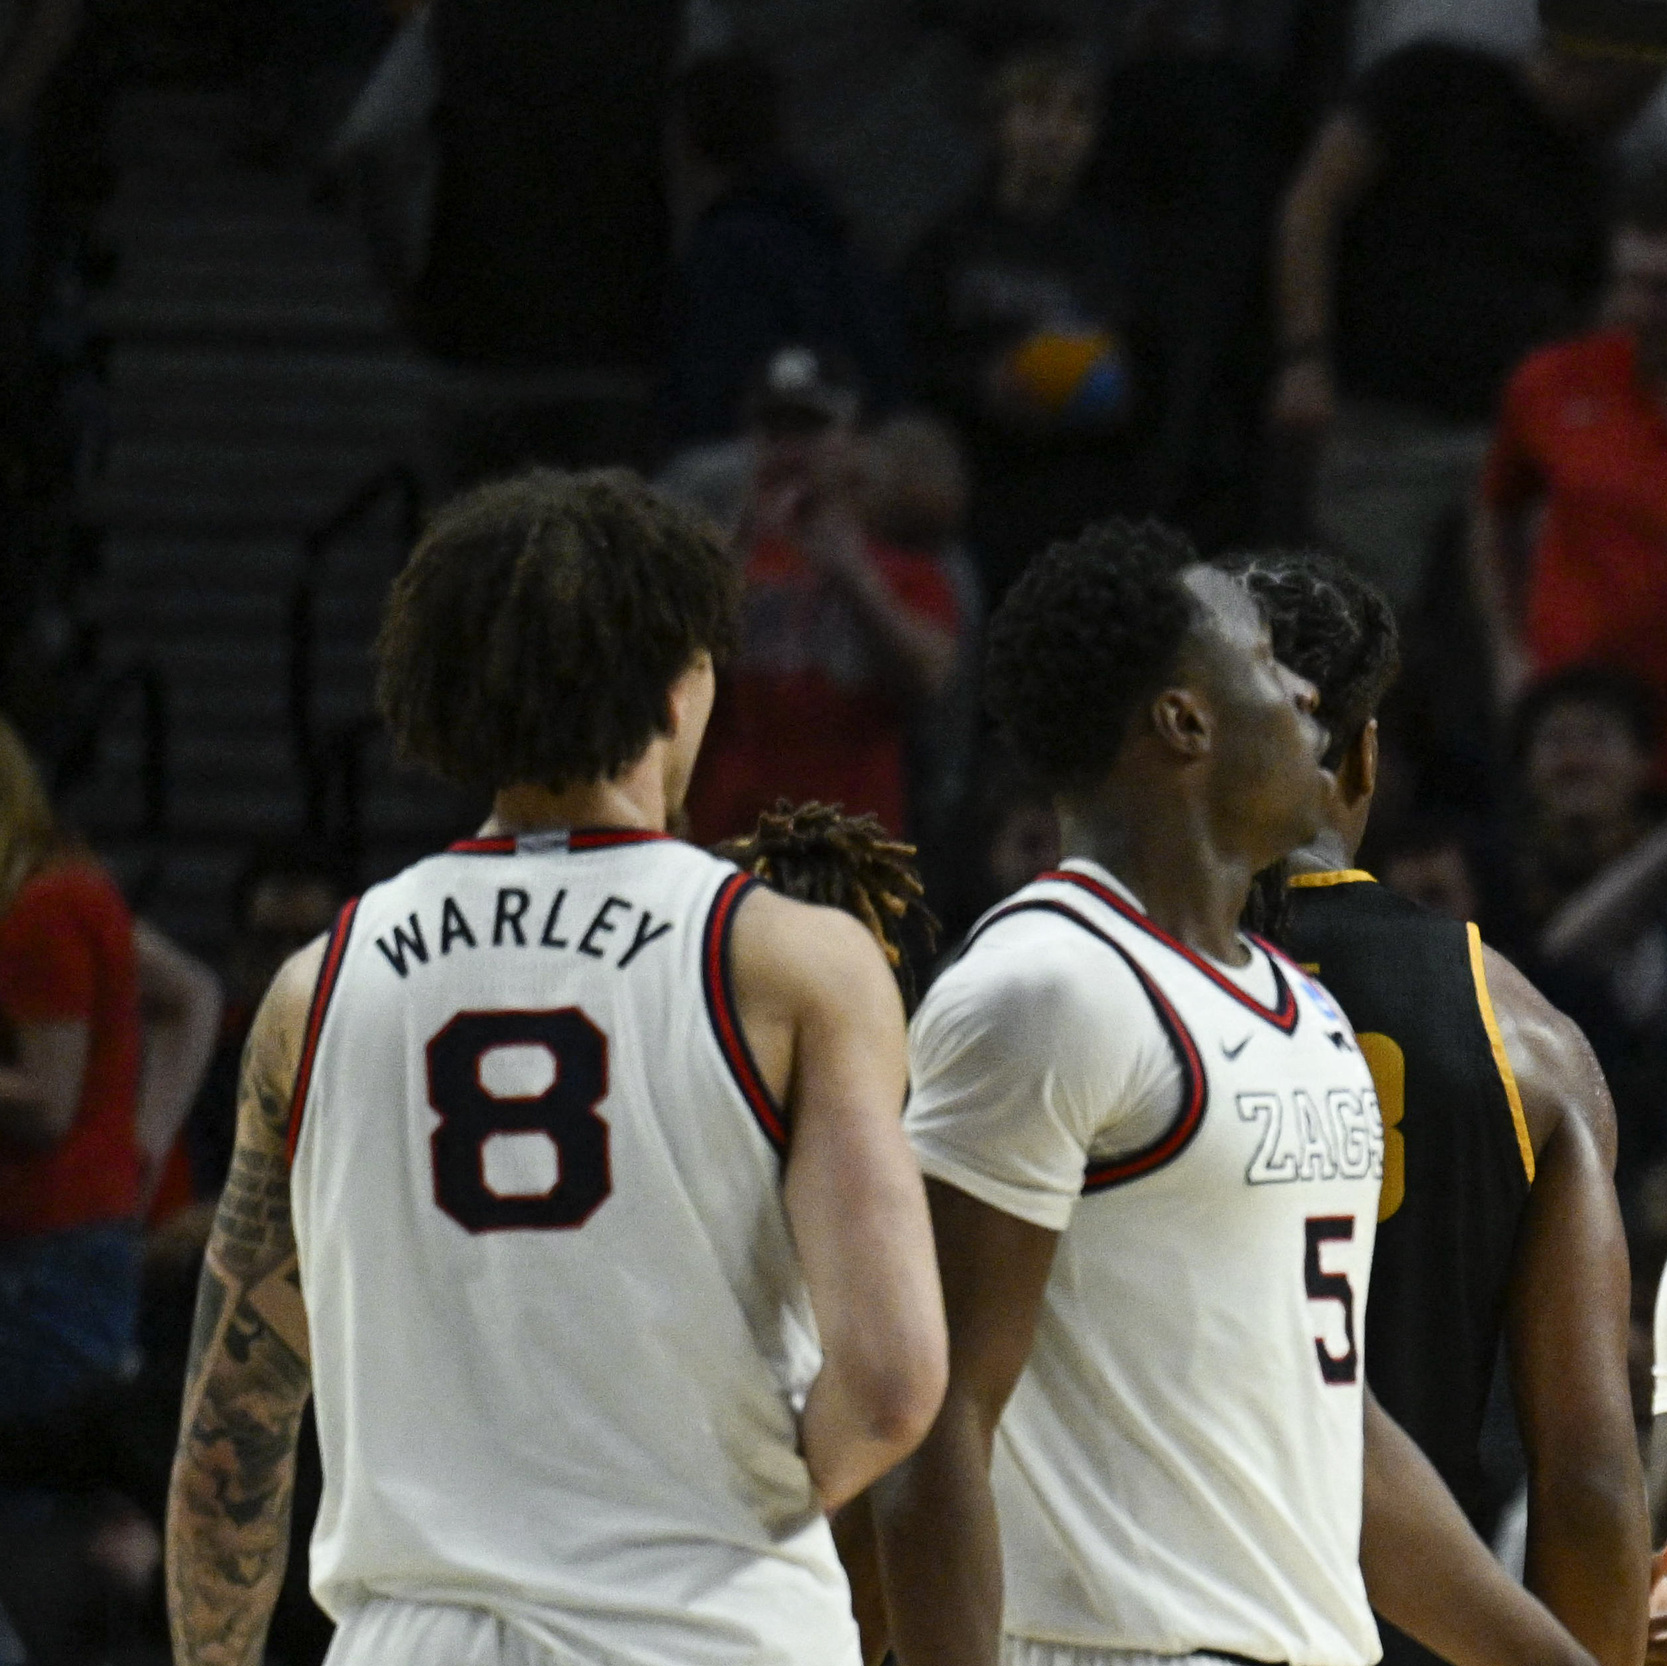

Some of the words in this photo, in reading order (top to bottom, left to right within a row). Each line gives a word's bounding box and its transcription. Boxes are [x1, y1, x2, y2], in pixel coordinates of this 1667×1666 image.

[375, 887, 674, 980] WARLEY
[426, 1006, 613, 1235] 8
[1303, 1215, 1358, 1386] 5
